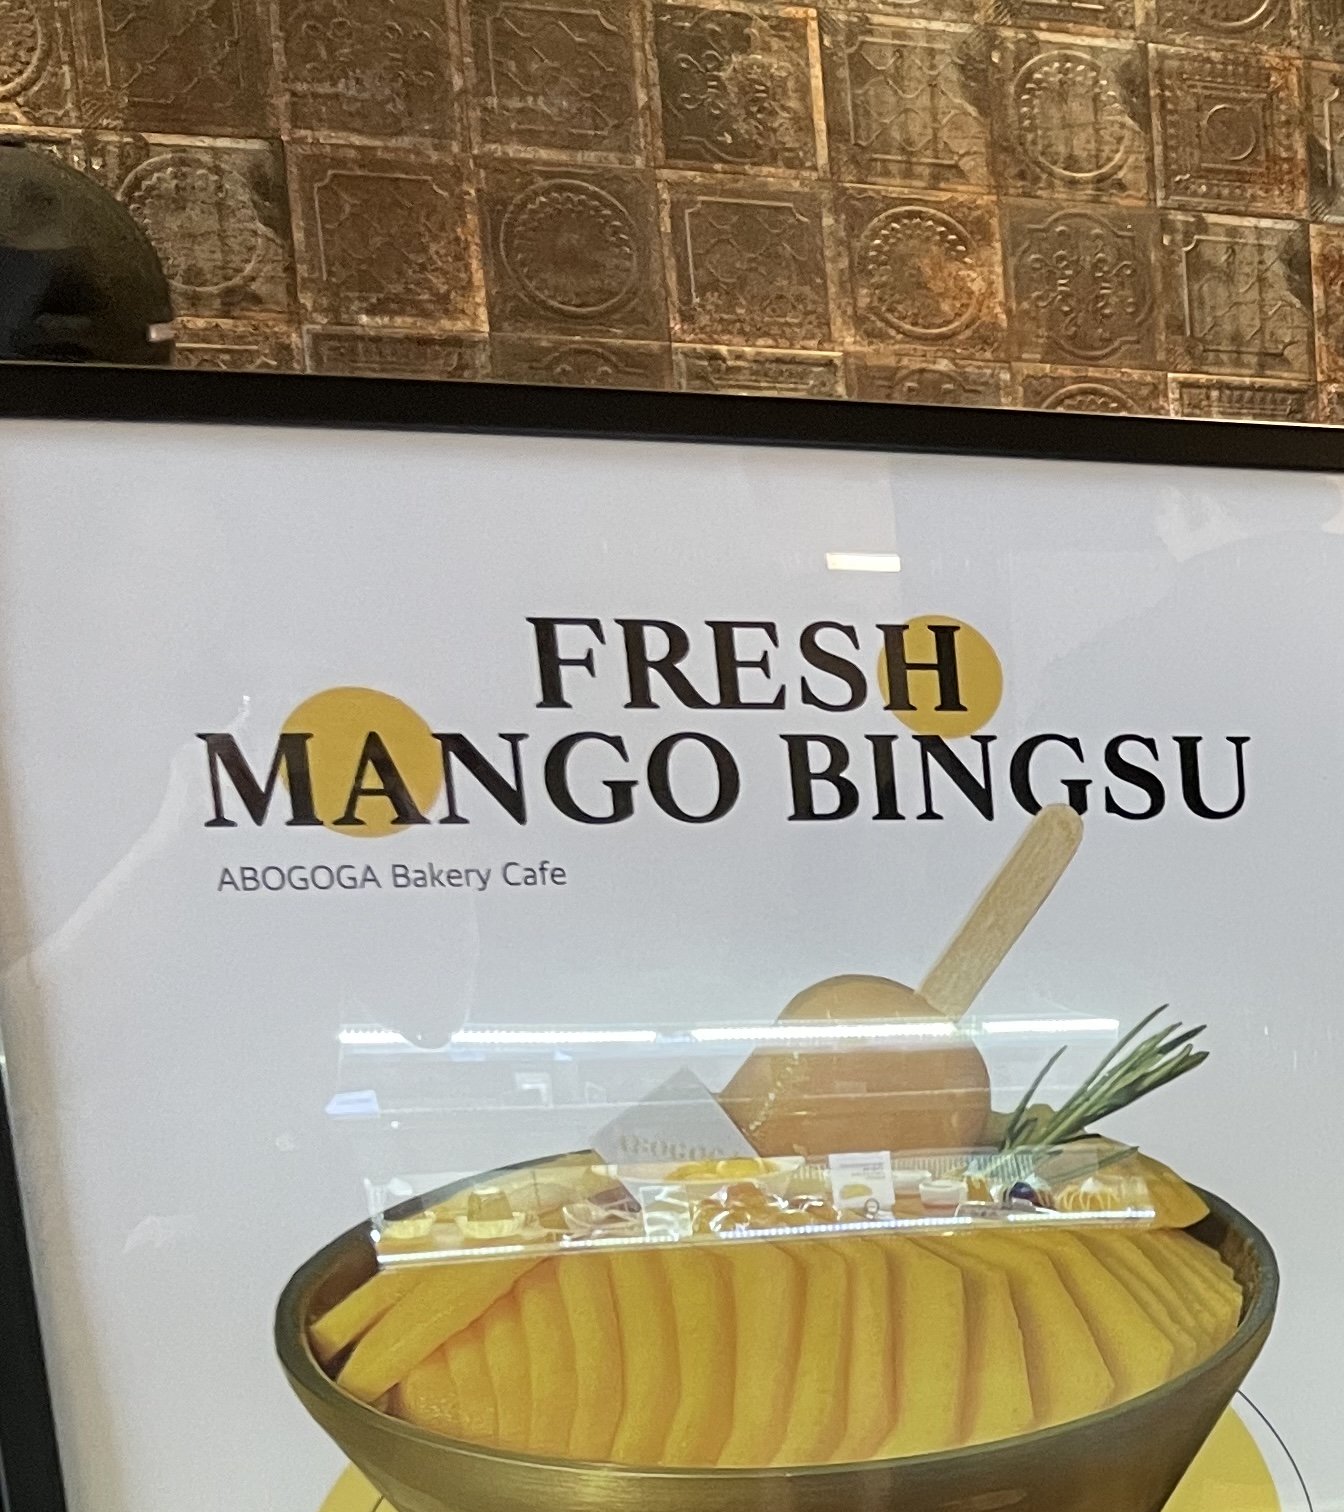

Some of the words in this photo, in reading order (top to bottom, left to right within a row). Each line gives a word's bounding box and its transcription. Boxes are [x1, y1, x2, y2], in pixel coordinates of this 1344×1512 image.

[527, 616, 968, 713] FRESH
[197, 731, 741, 829] MANGO
[783, 733, 1250, 825] BINGSU
[217, 862, 382, 892] ABOGOGA
[392, 861, 491, 893] Bakery
[501, 859, 567, 888] Cafe
